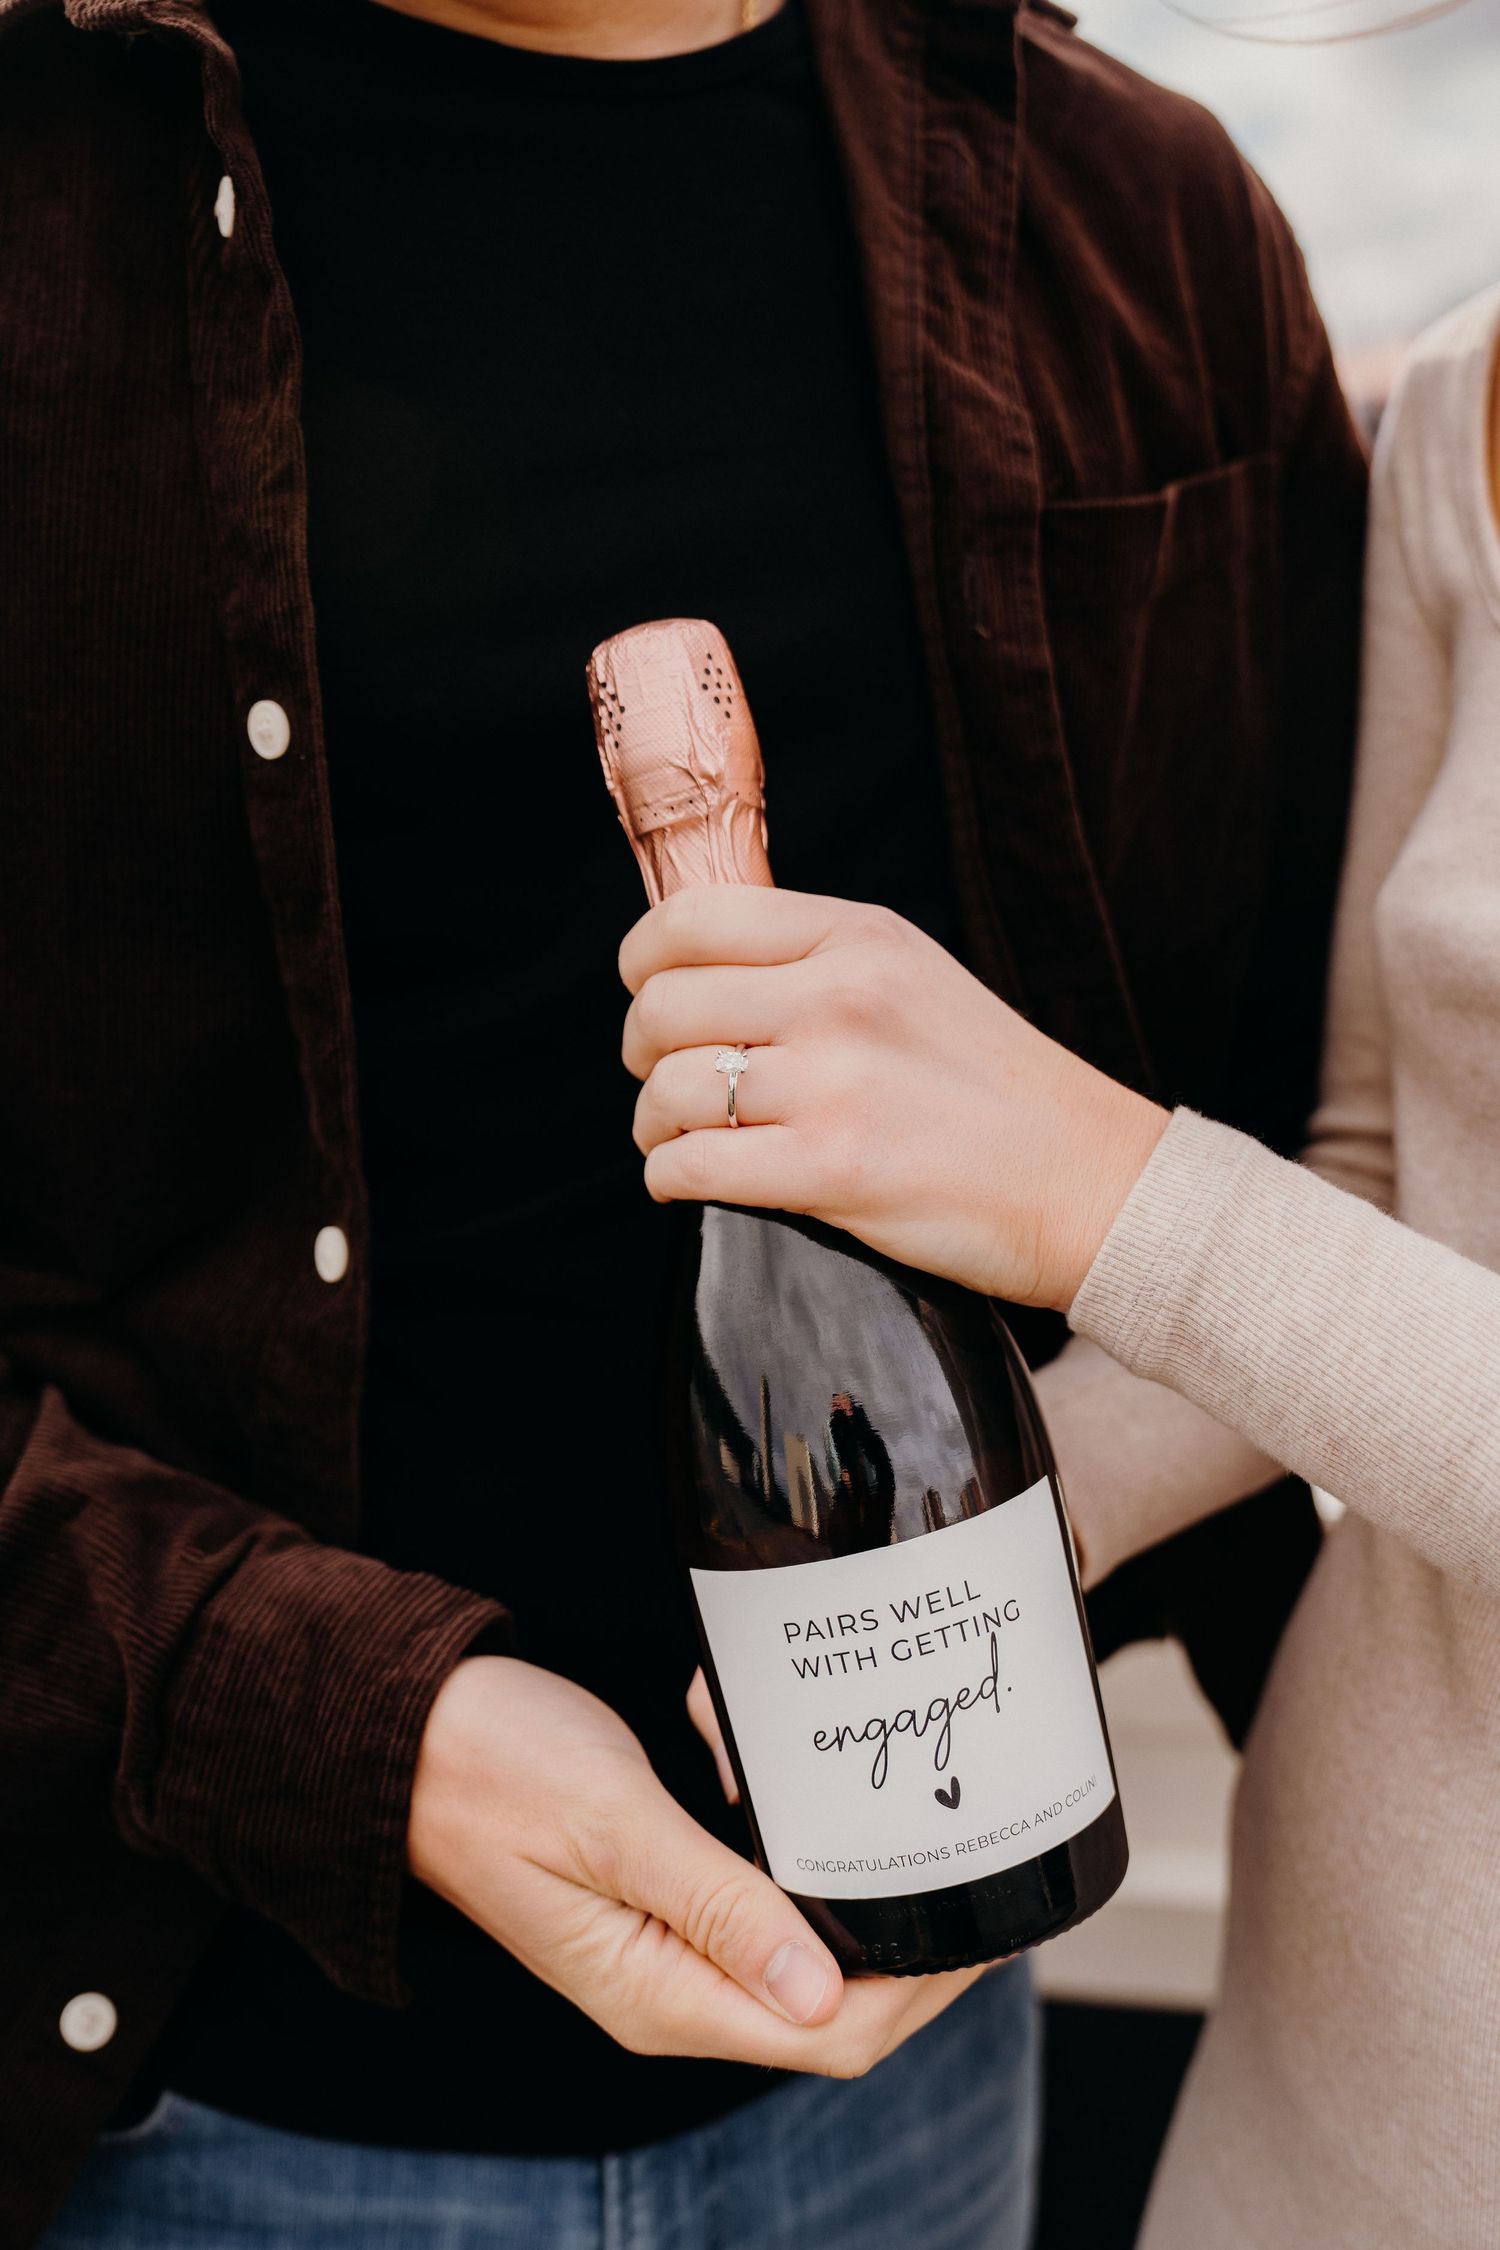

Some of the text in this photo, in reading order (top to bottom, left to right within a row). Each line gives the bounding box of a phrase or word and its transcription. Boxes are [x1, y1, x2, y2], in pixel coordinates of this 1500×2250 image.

[783, 1580, 982, 1644] PAIRS WELL
[791, 1599, 1021, 1679] WITH GETTING
[813, 1631, 1013, 1790] engaged.
[796, 1846, 951, 1873] CONGRATULATIONS
[954, 1819, 1032, 1856] REBECCA
[1034, 1801, 1063, 1828] AND
